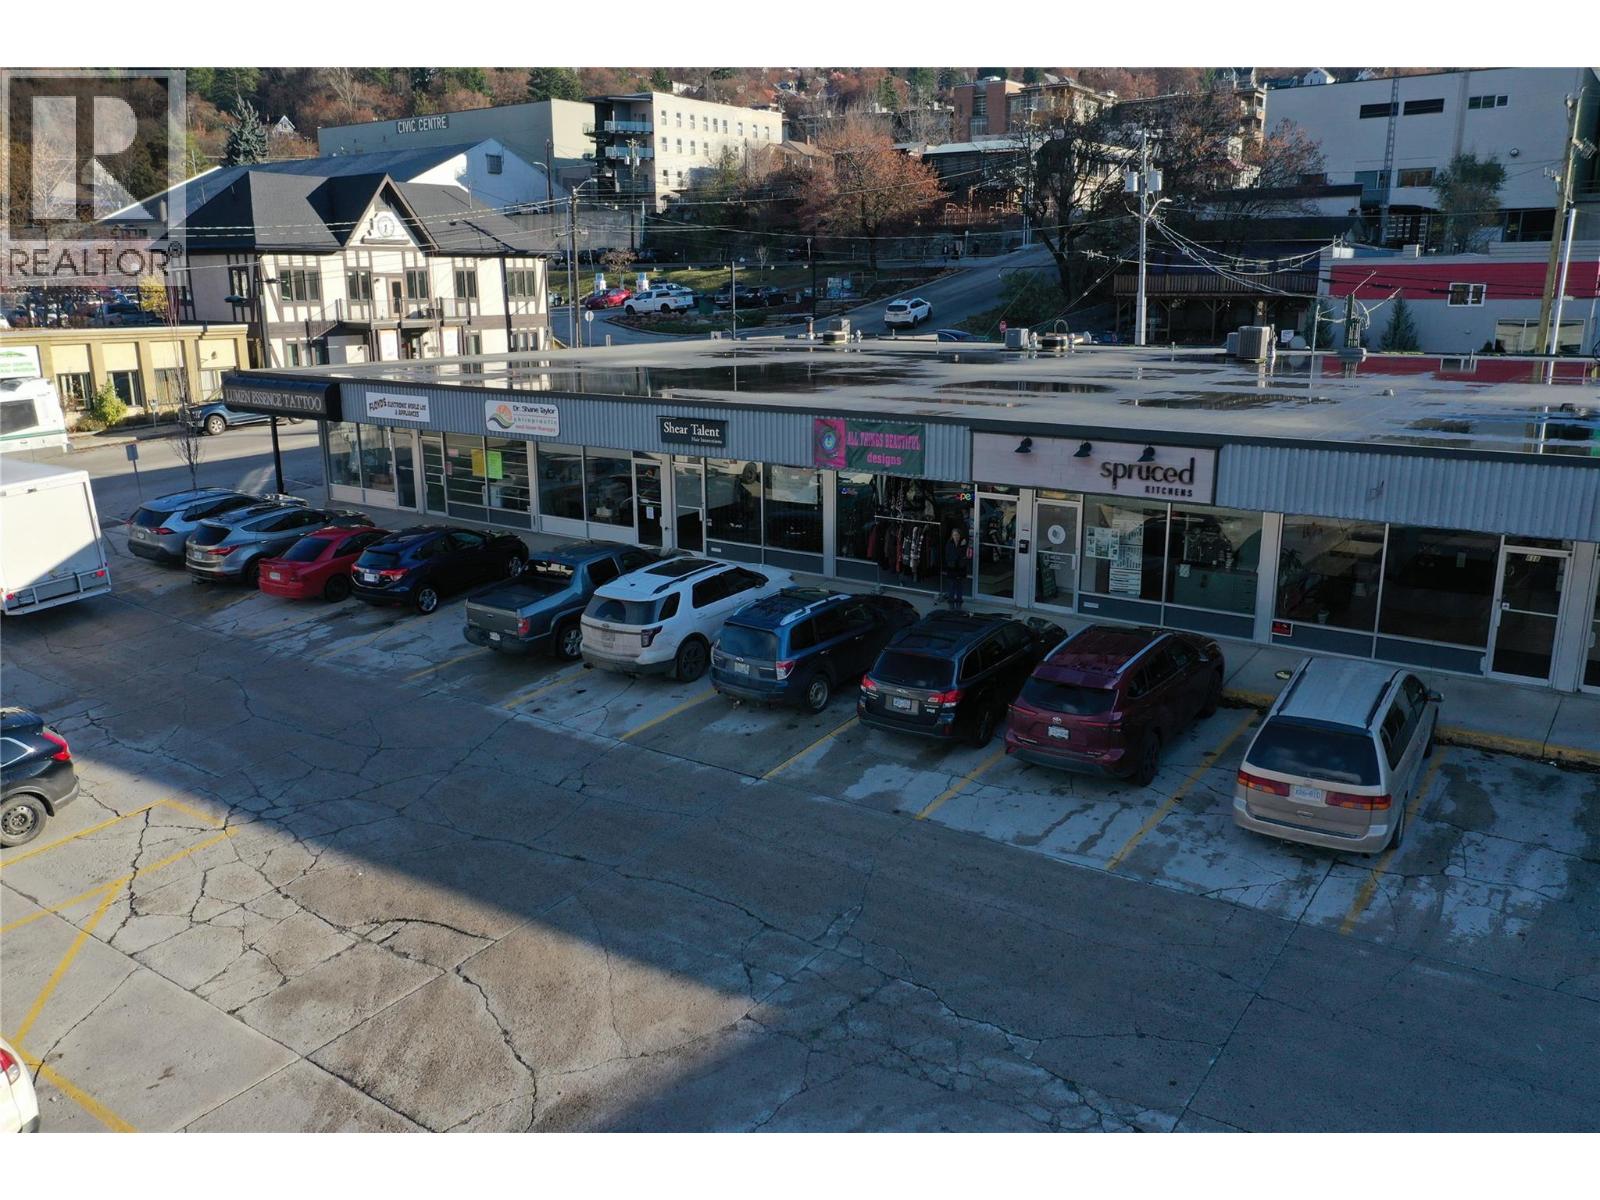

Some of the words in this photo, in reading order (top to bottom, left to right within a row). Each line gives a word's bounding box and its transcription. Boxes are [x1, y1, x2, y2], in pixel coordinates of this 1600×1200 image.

[398, 120, 416, 133] CIVIC
[418, 116, 447, 131] CENTRE
[225, 389, 251, 403] LUMEN
[251, 391, 282, 407] ESSENCE
[283, 394, 322, 411] TATTOO
[521, 405, 539, 413] Shane
[540, 407, 555, 415] Taylor
[663, 421, 688, 434] Shear
[690, 423, 720, 437] Talent
[846, 431, 859, 446] ALL
[860, 431, 883, 447] THINGS
[885, 433, 920, 450] BEAUTIFUL
[866, 451, 902, 468] designs
[1100, 457, 1195, 490] spruced
[1144, 485, 1193, 497] KITCHENS
